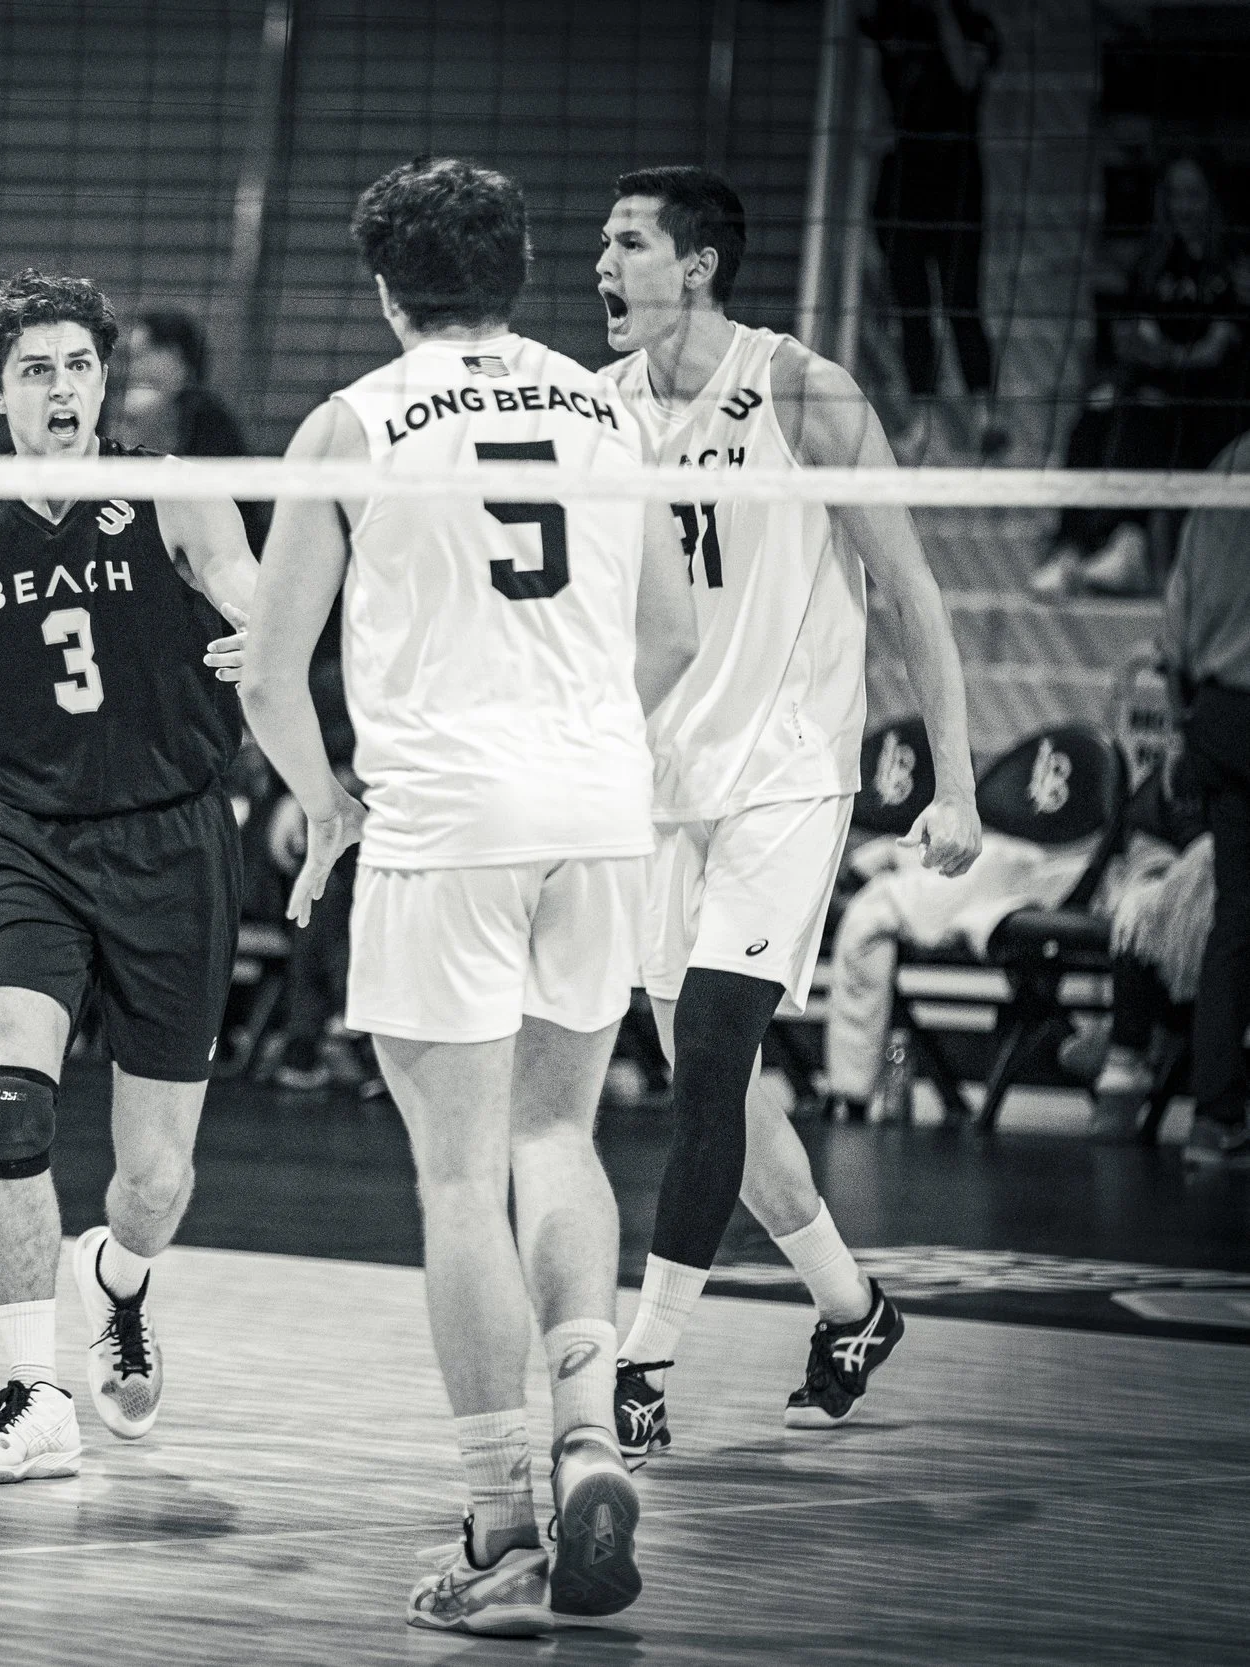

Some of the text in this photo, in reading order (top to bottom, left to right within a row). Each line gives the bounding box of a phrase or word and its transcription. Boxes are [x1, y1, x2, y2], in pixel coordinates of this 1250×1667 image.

[385, 385, 619, 447] LONG BEACH
[474, 439, 571, 602] 5
[40, 606, 105, 715] 3
